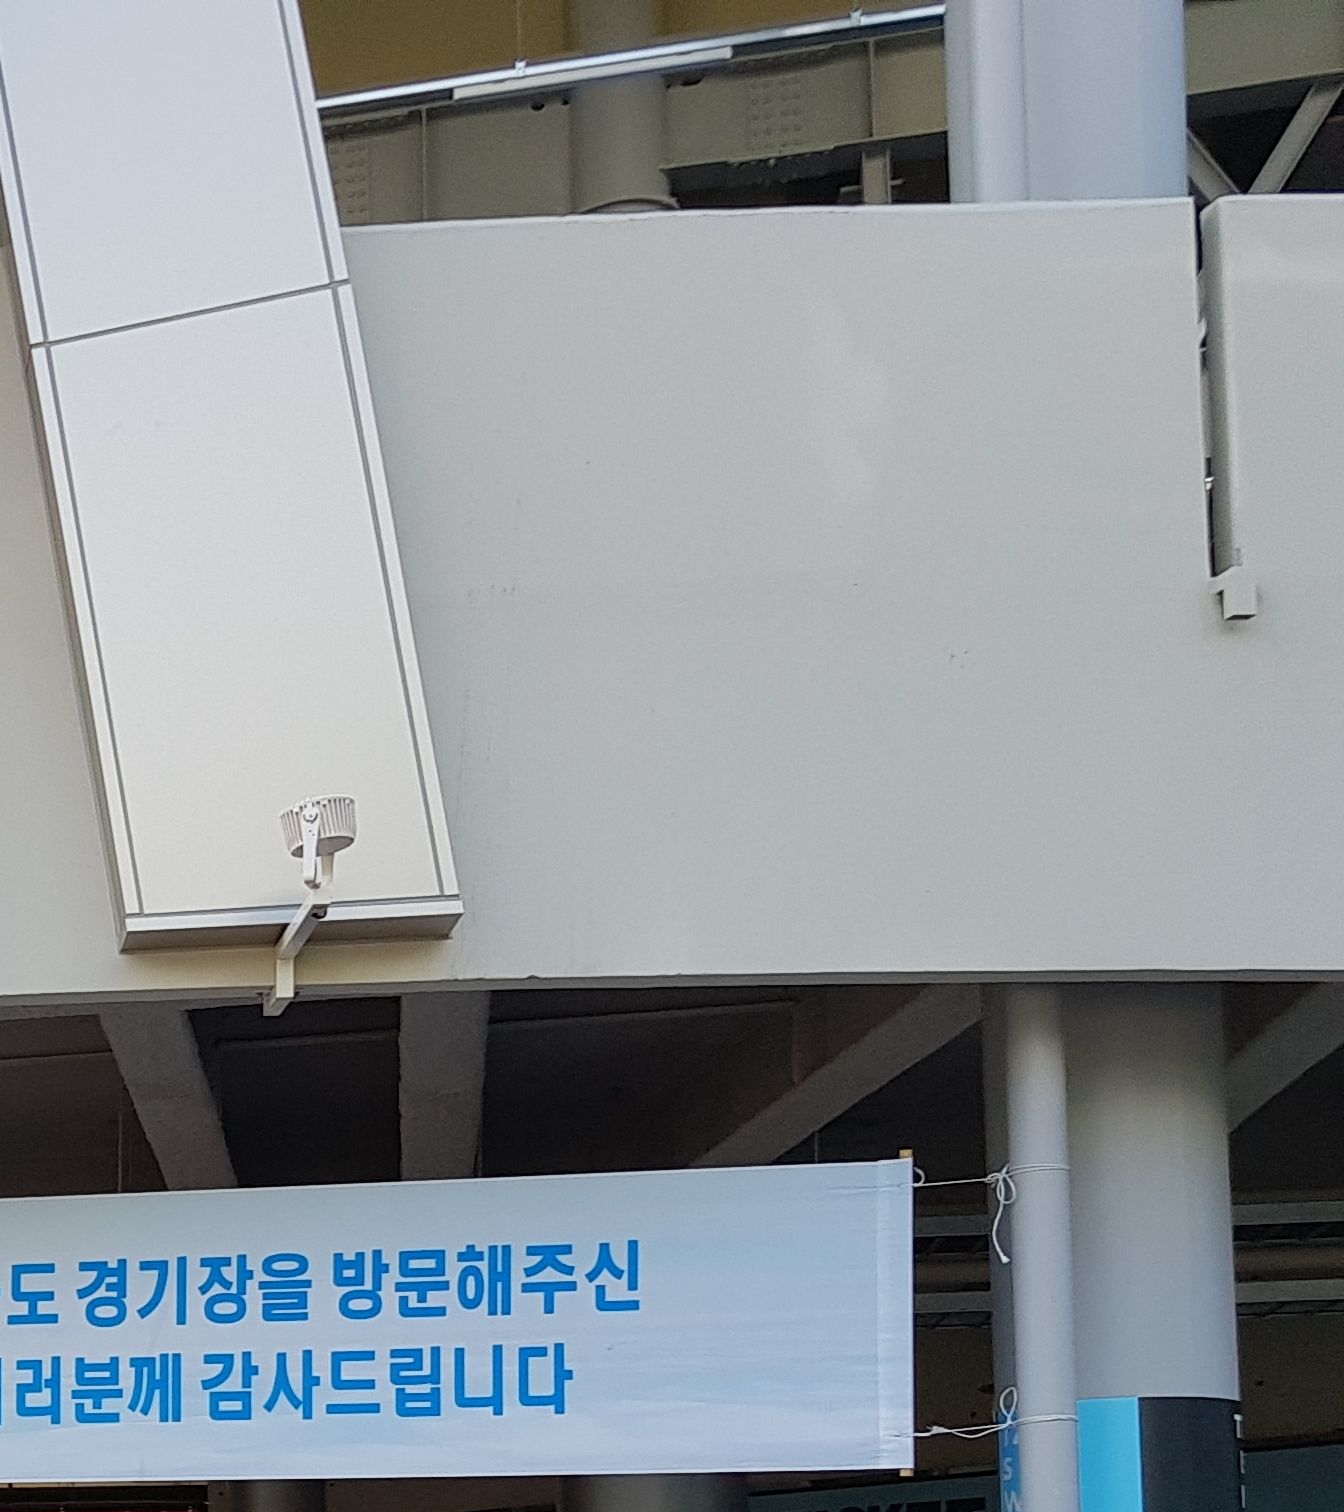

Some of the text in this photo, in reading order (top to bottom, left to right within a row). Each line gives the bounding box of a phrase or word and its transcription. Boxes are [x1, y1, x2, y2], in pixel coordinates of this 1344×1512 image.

[75, 1252, 313, 1327] 경기장을
[331, 1239, 641, 1319] 방문해주신
[199, 1342, 575, 1421] 감사드립니다
